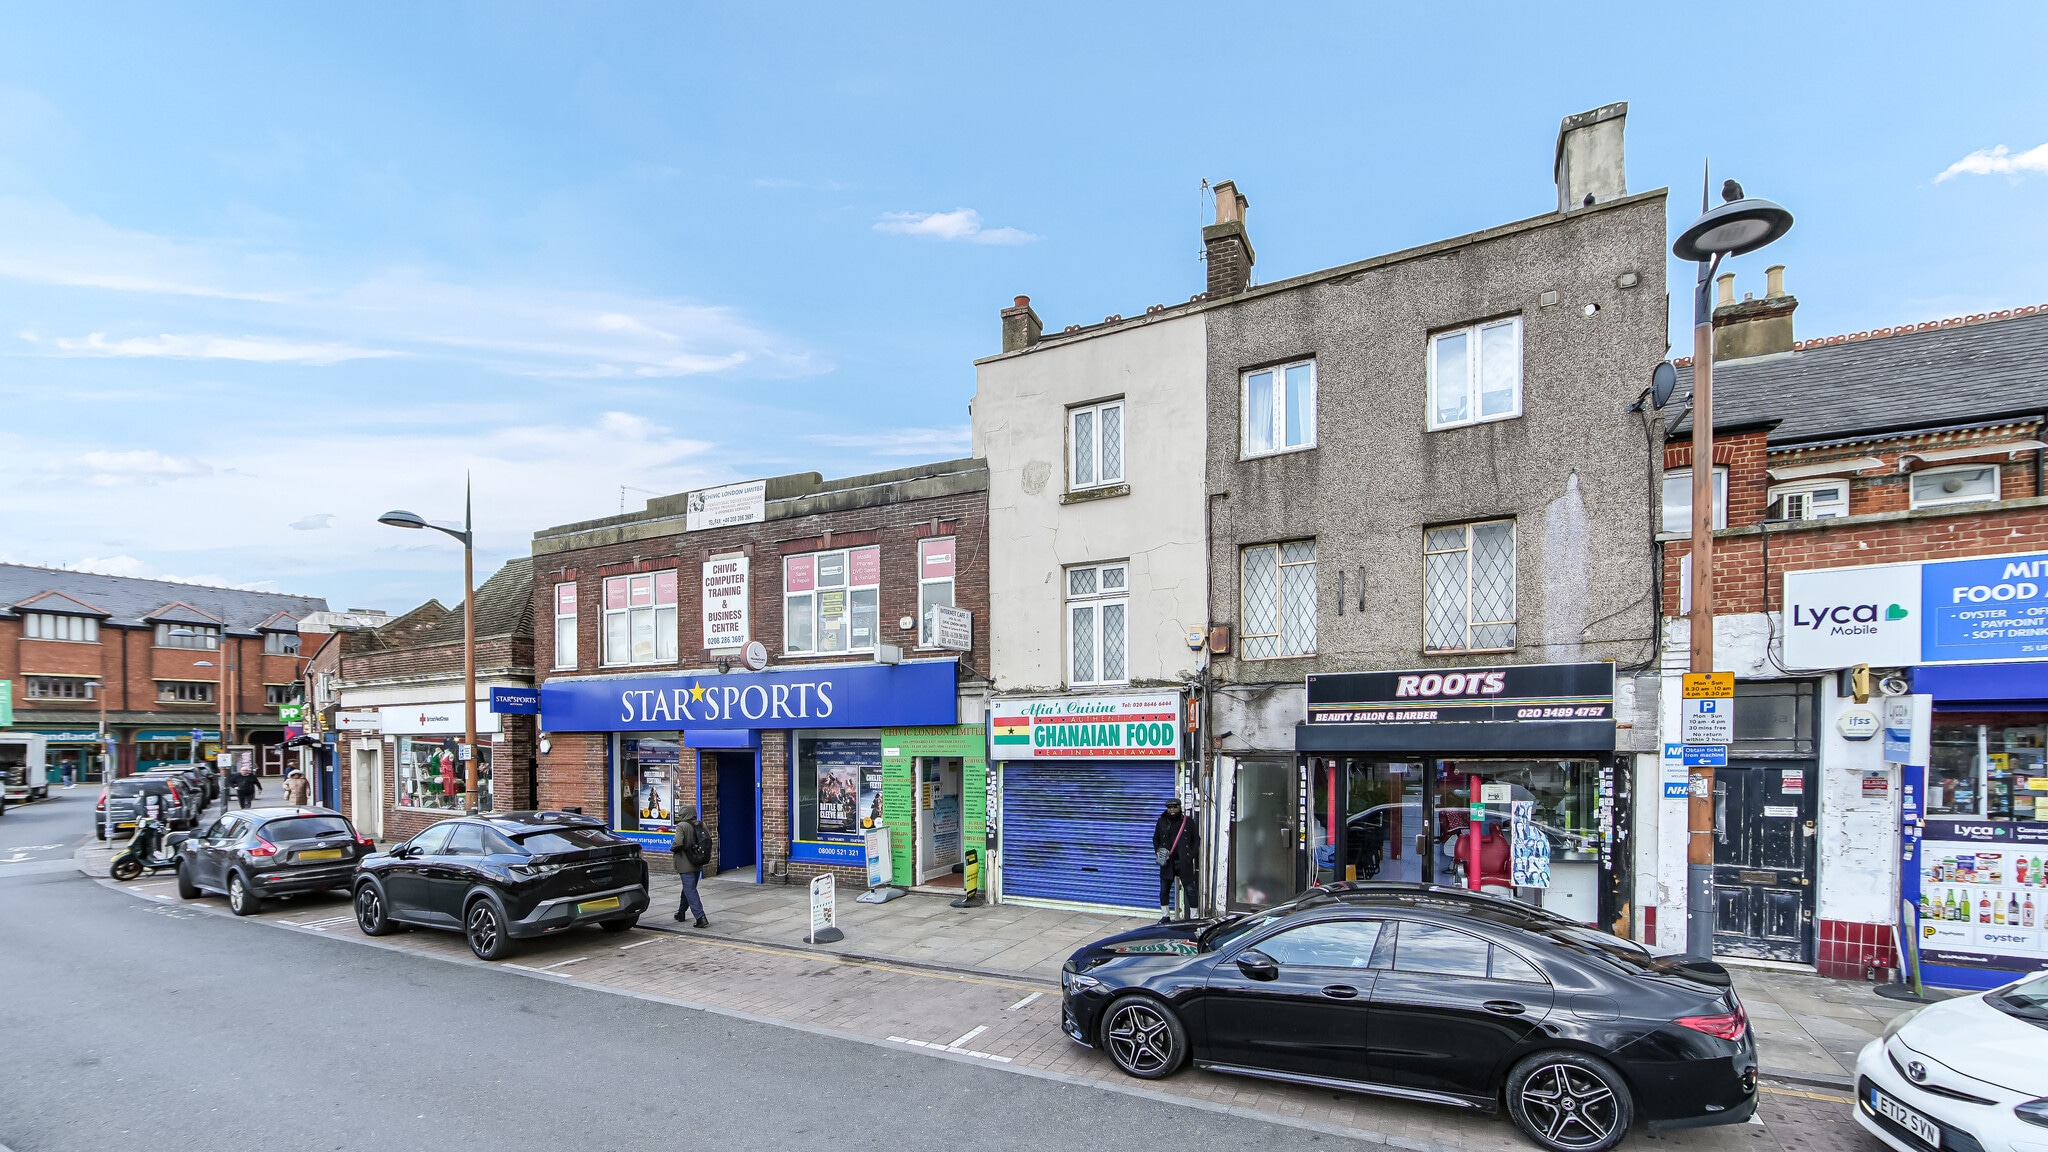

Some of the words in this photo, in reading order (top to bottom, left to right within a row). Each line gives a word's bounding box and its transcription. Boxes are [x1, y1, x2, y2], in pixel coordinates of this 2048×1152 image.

[722, 489, 743, 498] LONDON
[744, 485, 764, 494] LIMITED
[712, 563, 737, 574] CHIVIC
[705, 574, 745, 587] COMPUTER
[708, 586, 741, 598] TRAINING
[1953, 582, 2039, 604] FOOD
[722, 600, 728, 608] &
[708, 610, 742, 622] BUSINESS
[940, 608, 957, 617] INTERNET
[1794, 604, 1878, 630] Lyca
[1959, 609, 2007, 620] OYSTER
[711, 622, 739, 633] CENTRE
[1981, 617, 2046, 628] PAYPOINT
[1831, 625, 1878, 636] Mobile
[1972, 629, 2005, 639] SOFT
[1396, 672, 1506, 697] ROOTS
[621, 689, 696, 722] STAR
[705, 681, 833, 721] SPORTS
[1703, 701, 1714, 712] P
[1021, 703, 1061, 717] Afia's
[1066, 701, 1116, 714] Cuisine
[1517, 708, 1542, 718] 020
[1543, 707, 1573, 718] 3489
[1574, 707, 1605, 717] 4757
[1071, 714, 1134, 722] AUTHENTIC
[1315, 712, 1353, 722] BEAUTY
[1353, 712, 1386, 721] SALON
[1386, 711, 1395, 720] &
[1395, 711, 1439, 720] BARBER
[1849, 716, 1870, 726] ifss
[883, 728, 911, 736] CHIVIC
[913, 727, 950, 736] LONDON
[951, 727, 985, 736] LIMITED
[1034, 724, 1120, 747] GHANAIAN
[1126, 723, 1174, 746] FOOD
[1667, 747, 1682, 755] NH
[820, 803, 836, 811] BATTLE
[820, 811, 836, 819] CLEEVE
[837, 811, 847, 820] HILL
[1954, 824, 1993, 836] Lyca
[1984, 934, 2028, 943] oyster
[1881, 1097, 1907, 1125] ET12
[1911, 1115, 1934, 1142] SVN
